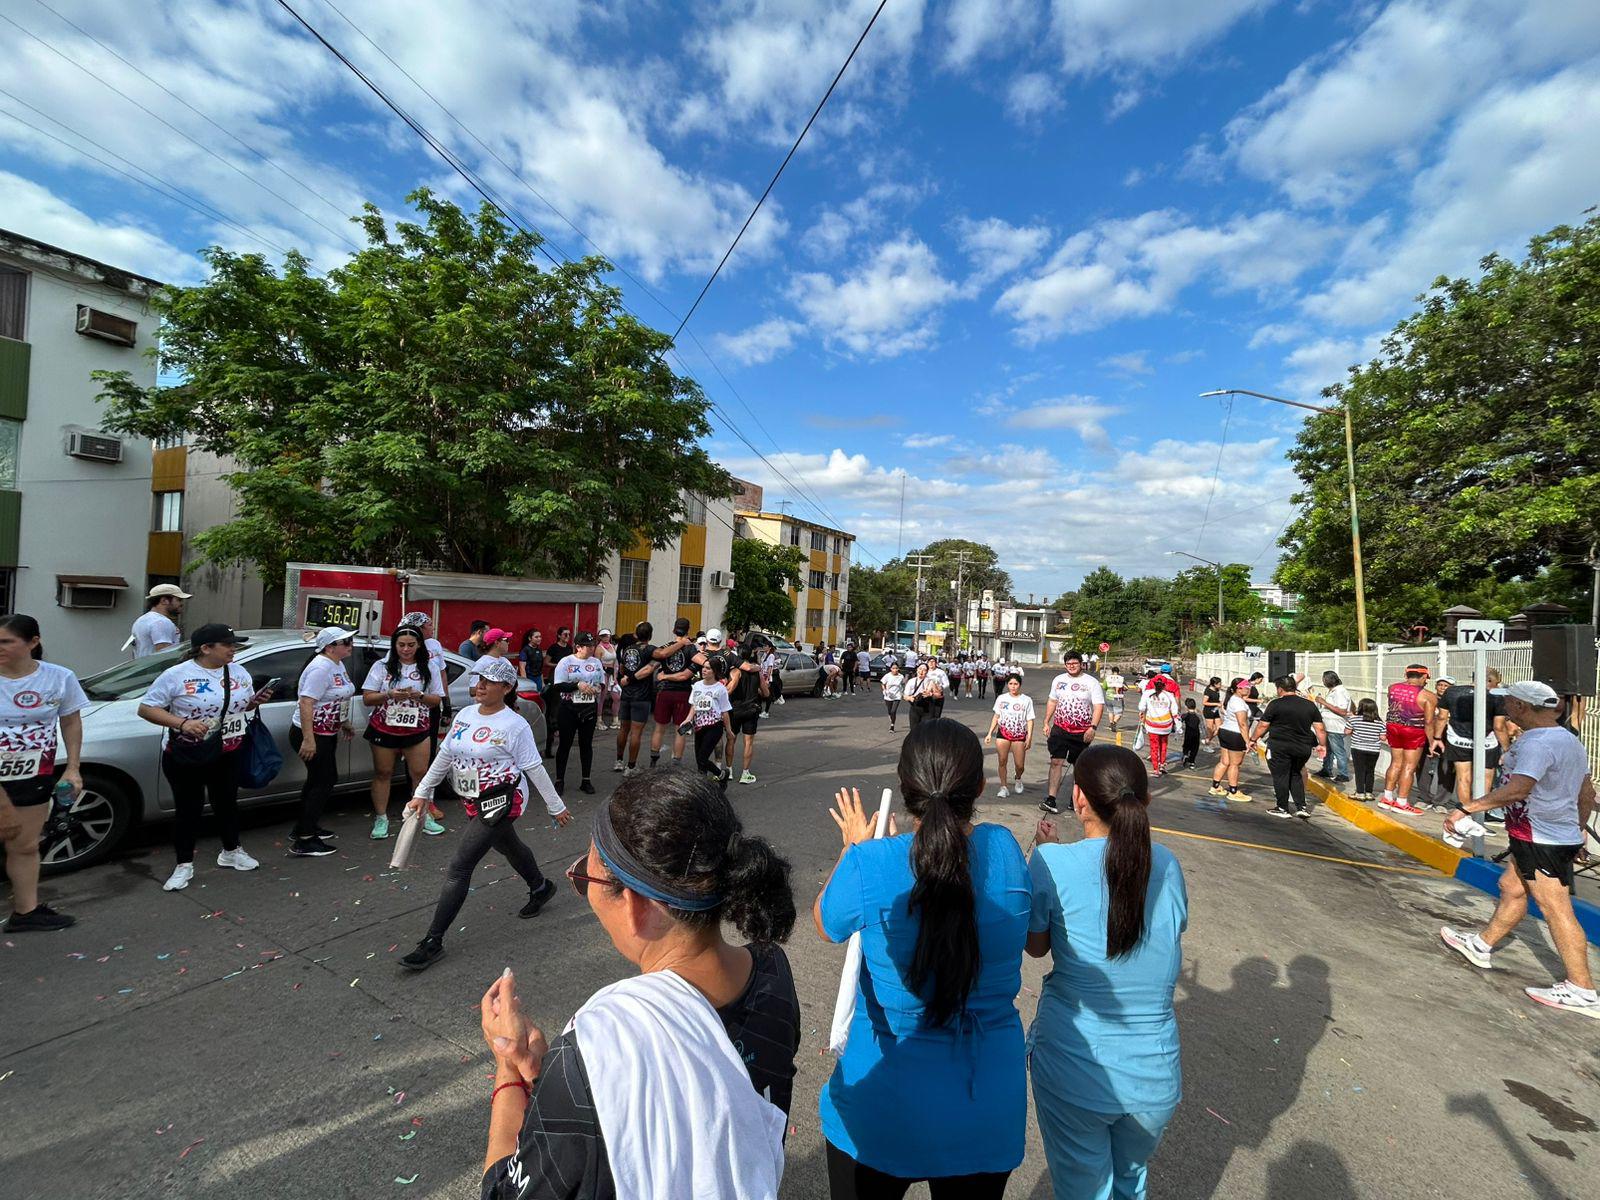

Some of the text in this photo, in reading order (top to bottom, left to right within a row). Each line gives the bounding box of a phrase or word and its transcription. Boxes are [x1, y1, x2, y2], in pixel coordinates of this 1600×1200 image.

[1001, 630, 1035, 638] HELENA
[221, 719, 242, 736] 549
[0, 759, 36, 777] 552
[483, 796, 505, 810] PUMA
